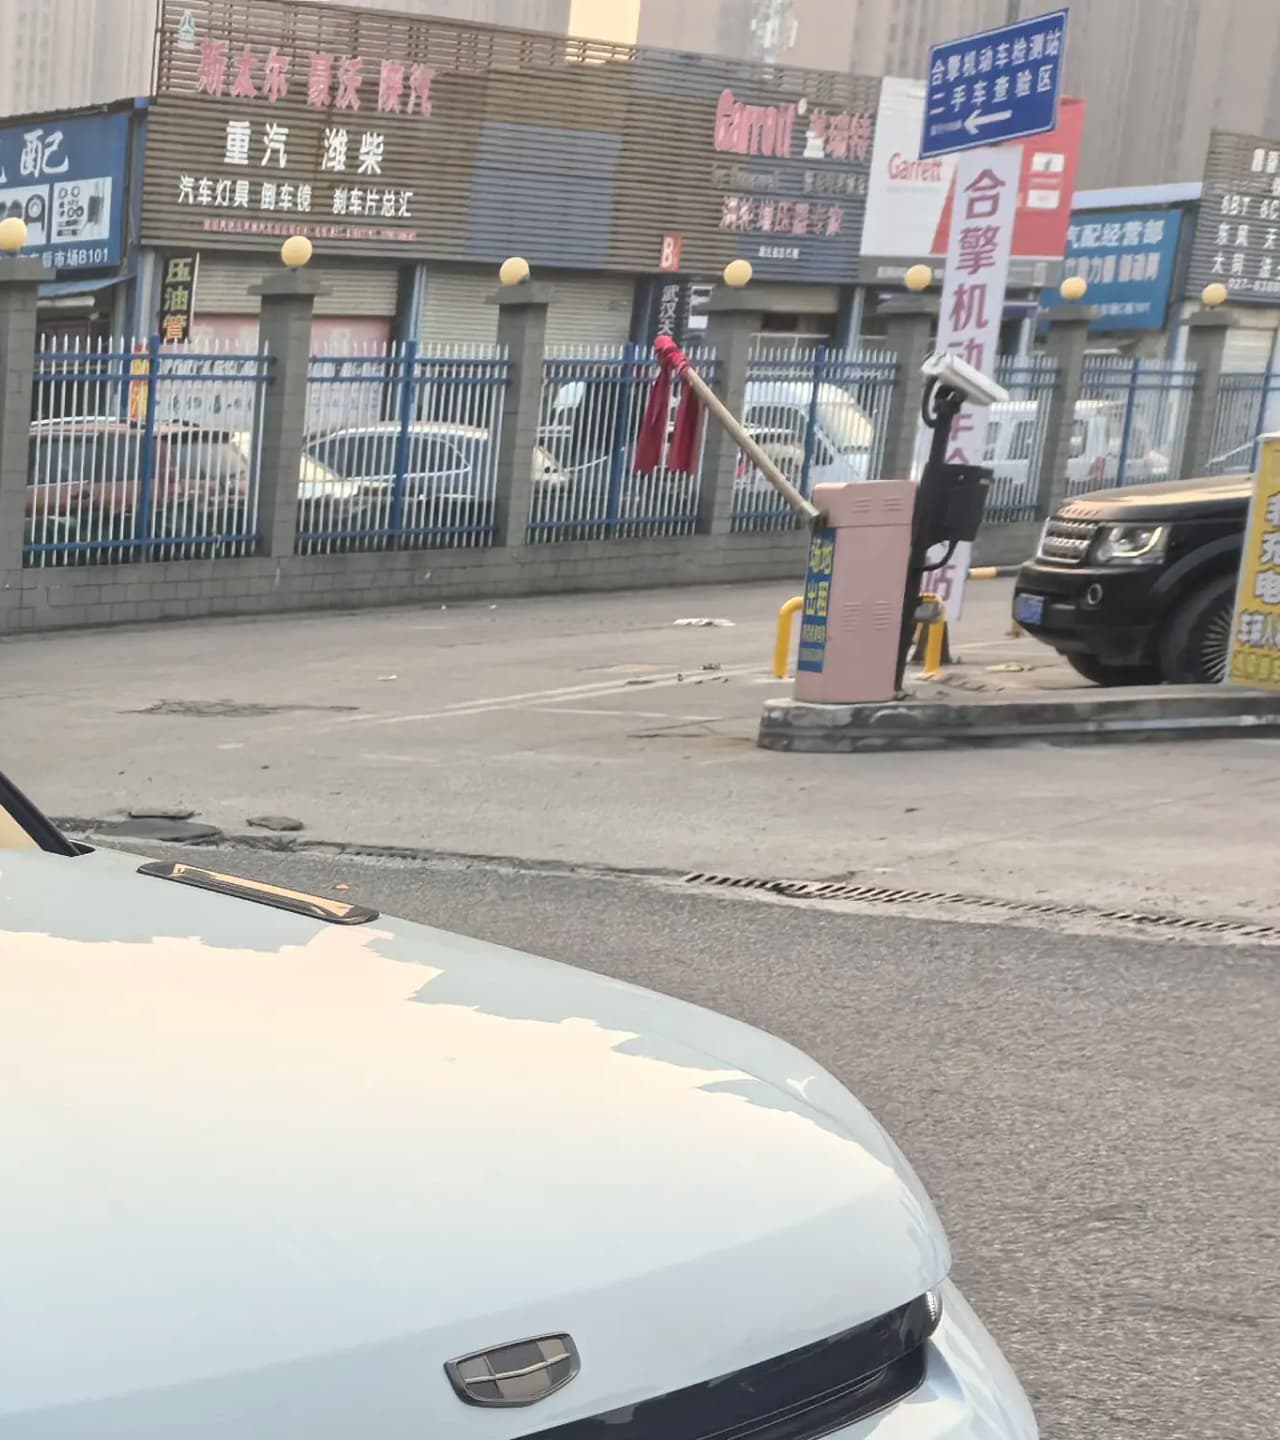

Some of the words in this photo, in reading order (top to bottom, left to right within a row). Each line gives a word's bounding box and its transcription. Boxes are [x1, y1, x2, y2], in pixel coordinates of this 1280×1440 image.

[931, 28, 1061, 86] 合擎机动车检测站
[929, 64, 1054, 116] 二手车查验区
[223, 120, 289, 168] 重汽
[321, 127, 385, 175] 潍柴
[888, 151, 944, 182] Garrett
[178, 174, 250, 208] 汽车灯具
[260, 182, 313, 212] 倒车镜
[332, 187, 414, 217] 刹车片总汇
[162, 257, 192, 340] 压油管
